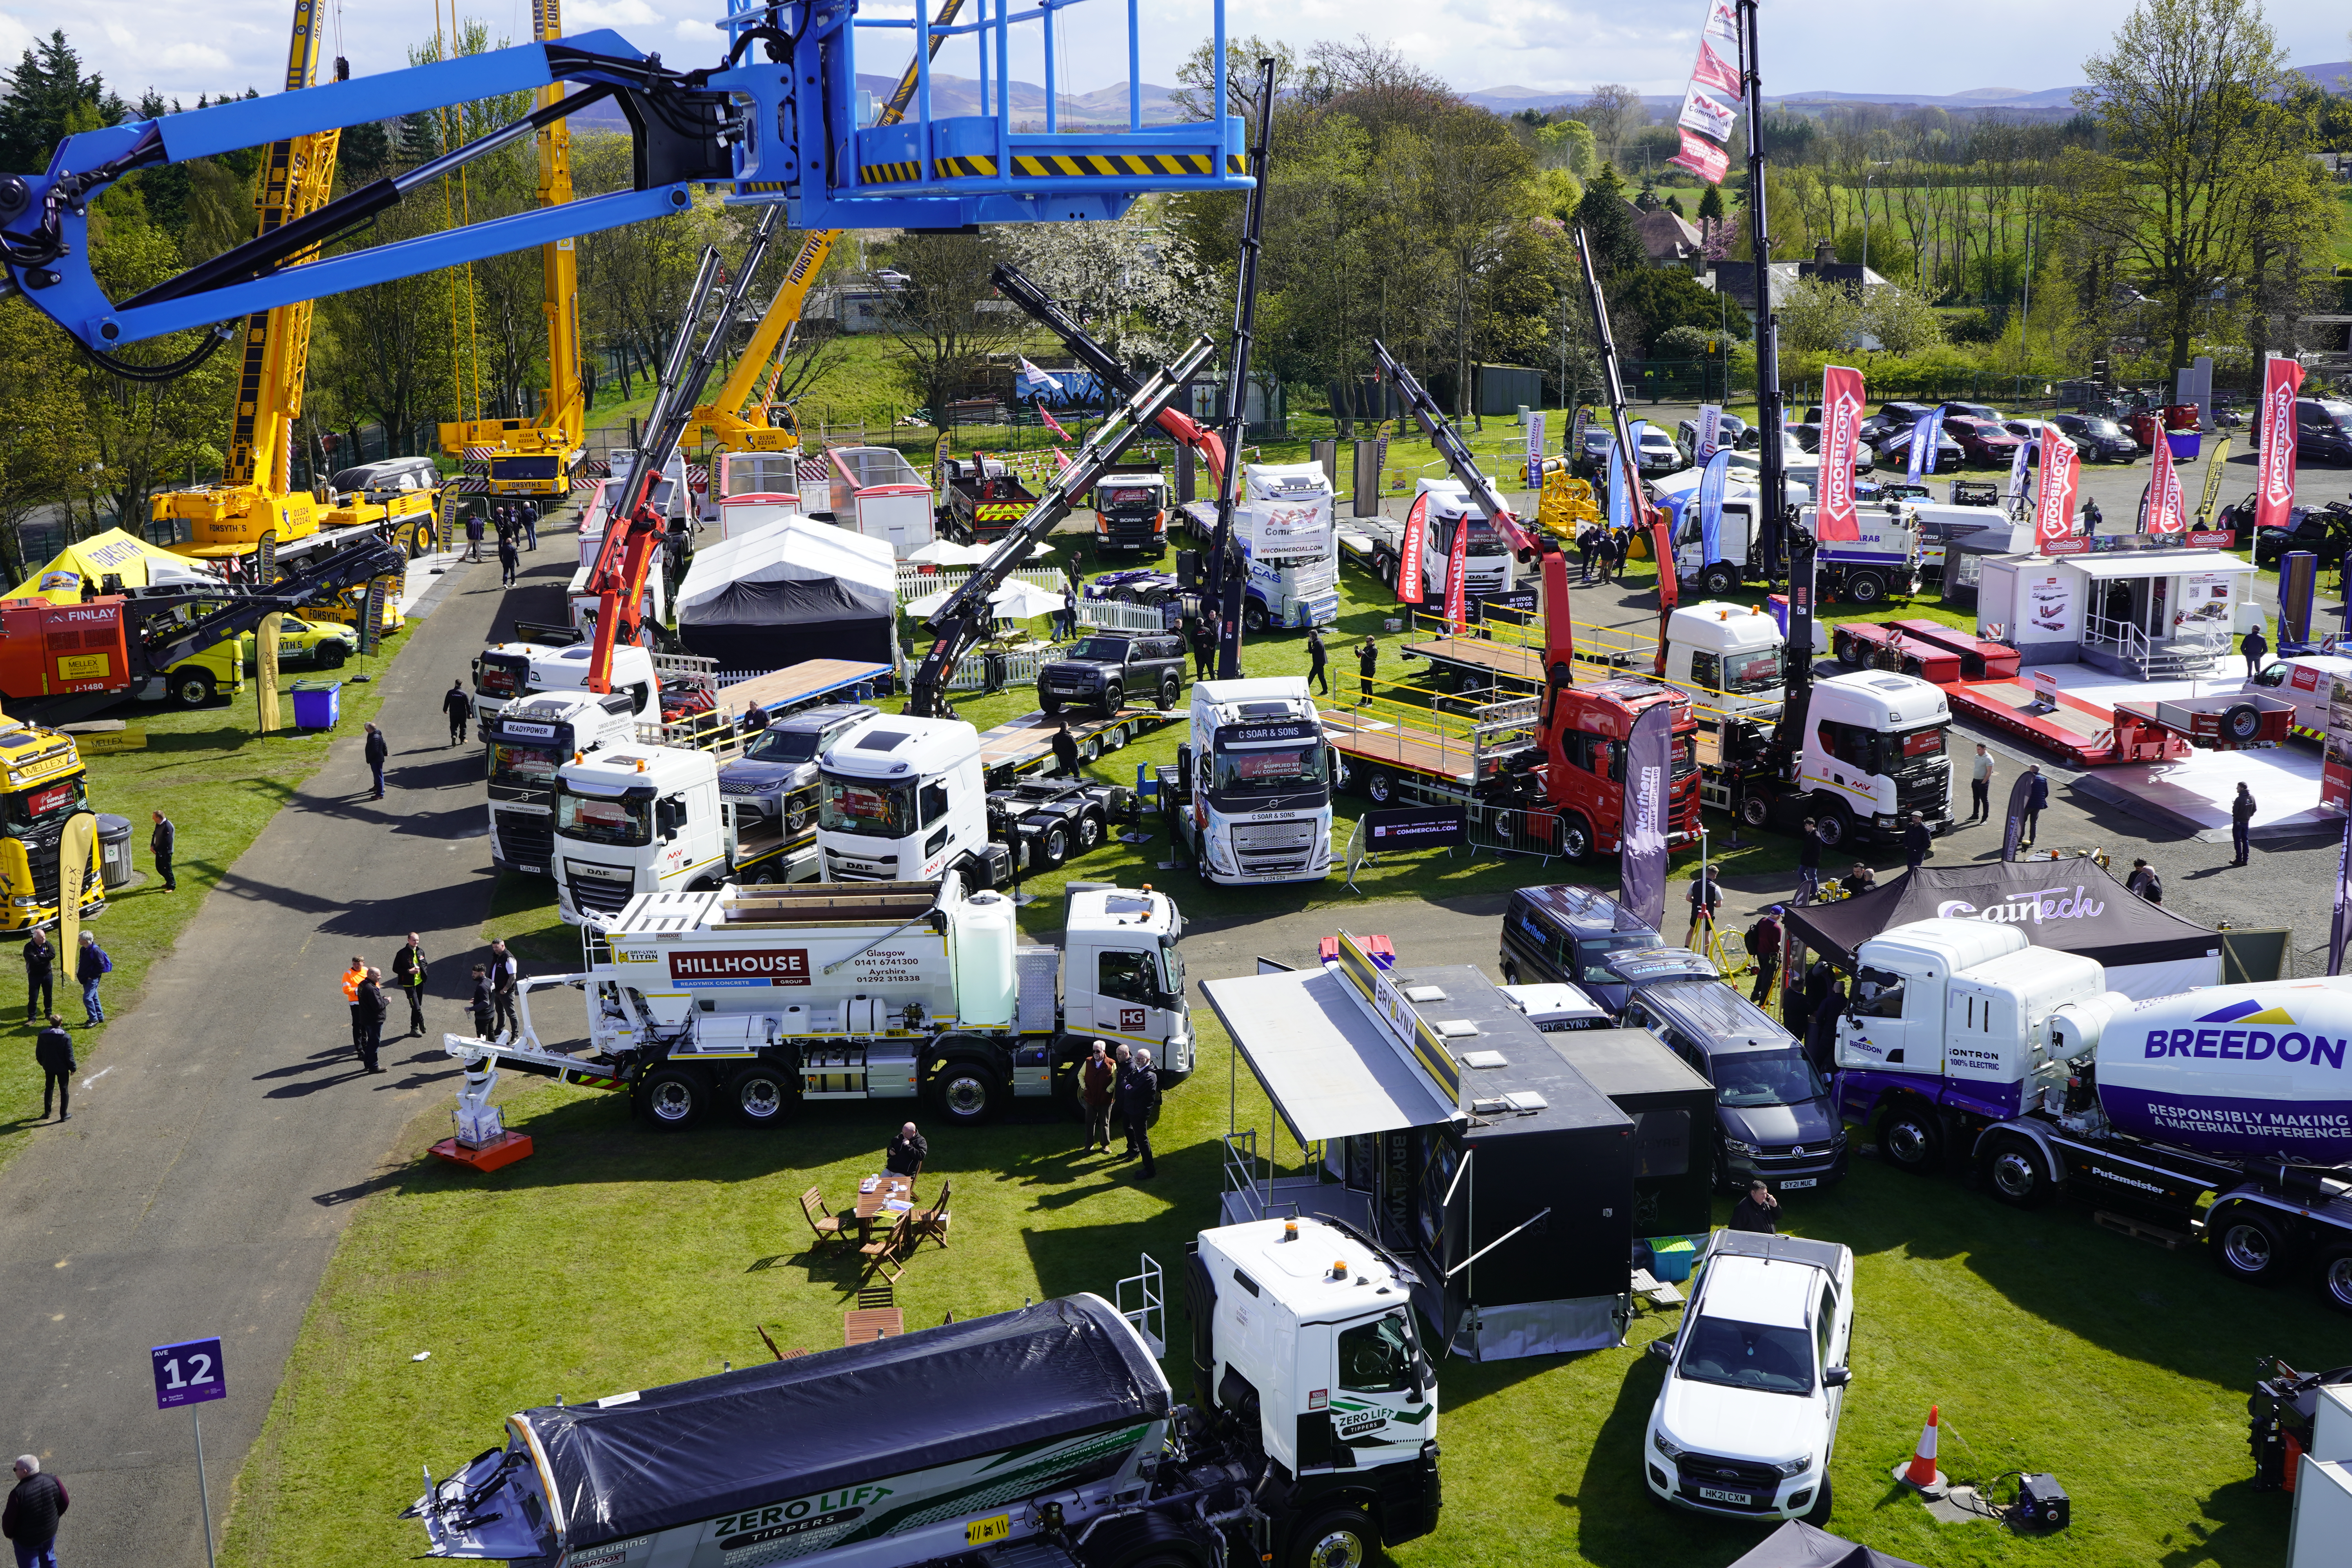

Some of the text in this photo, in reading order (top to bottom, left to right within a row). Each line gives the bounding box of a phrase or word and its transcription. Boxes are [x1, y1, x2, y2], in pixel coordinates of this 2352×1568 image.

[1681, 118, 1728, 140] MVCOMMERCIAL.COM
[2266, 393, 2274, 421] SPECIAL
[1706, 410, 1714, 439] murray
[2270, 393, 2288, 495] NOOTEBOOM
[1831, 404, 1850, 507] NOOTEBOOM
[2154, 464, 2162, 490] TRAILERS
[2047, 445, 2069, 529] NOOTEBOOM
[293, 515, 310, 526] 822141
[294, 507, 309, 517] 01324
[87, 539, 144, 569] FORSYTH
[1260, 545, 1323, 554] MVCOMMERCIAL.COM
[1405, 524, 1419, 598] FRUEHAUF
[1797, 586, 1806, 604] HIAB
[69, 608, 116, 622] FINLAY
[309, 609, 341, 622] FORSYTH
[934, 640, 947, 654] HIAB
[69, 659, 98, 668] MELLEX
[74, 683, 103, 692] J-1480
[508, 724, 548, 735] READYPOWER
[596, 723, 630, 735] www.readypower.com
[618, 717, 627, 725] 2407
[1247, 729, 1269, 738] SOAR
[1278, 727, 1299, 736] SONS
[91, 737, 123, 748] MELLEX
[26, 757, 64, 775] MELLEX
[1912, 776, 1936, 788] SCANIA
[2325, 774, 2344, 784] INNOVATION
[46, 793, 67, 804] SUPPLIED
[46, 797, 74, 809] COMMERCIAL
[1635, 766, 1651, 832] Northern
[1387, 825, 1457, 836] MVCOMMERCIAL.COM
[67, 866, 77, 921] MELLEX
[1521, 916, 1546, 945] Northern
[867, 950, 905, 958] Glasgow
[677, 956, 801, 973] HILLHOUSE
[1632, 964, 1687, 974] Northern
[1122, 1011, 1143, 1024] HG
[1378, 983, 1414, 1040] BAY LYNX
[1564, 1020, 1590, 1030] LYNX
[1849, 1040, 1882, 1054] BREEDON
[2145, 1029, 2347, 1069] BREEDON
[1950, 1058, 1999, 1070] 100% ELECTRIC
[2148, 1103, 2349, 1126] RESPONSIBLY MAKING
[2155, 1116, 2352, 1138] A MATERIAL DIFFERENCE
[1392, 1135, 1406, 1232] BAY LYNX
[2092, 1167, 2164, 1194] Putzmeister
[163, 1354, 214, 1390] 12
[1339, 1408, 1394, 1427] ZERO LIFT
[1350, 1422, 1377, 1433] TIPPERS
[1063, 1434, 1127, 1459] EFFECTIVE LIVE BOTTOM
[1706, 1489, 1745, 1503] HK21 CXM
[715, 1485, 894, 1537] ZERO LIFT
[751, 1516, 835, 1541] TIPPERS
[725, 1523, 850, 1557] AGGREGATES ASPHALTS
[725, 1530, 839, 1561] VERSATILE STRONG
[570, 1537, 648, 1562] FEATURING
[723, 1538, 819, 1566] SAFE LOW
[574, 1553, 621, 1568] HARDOX
